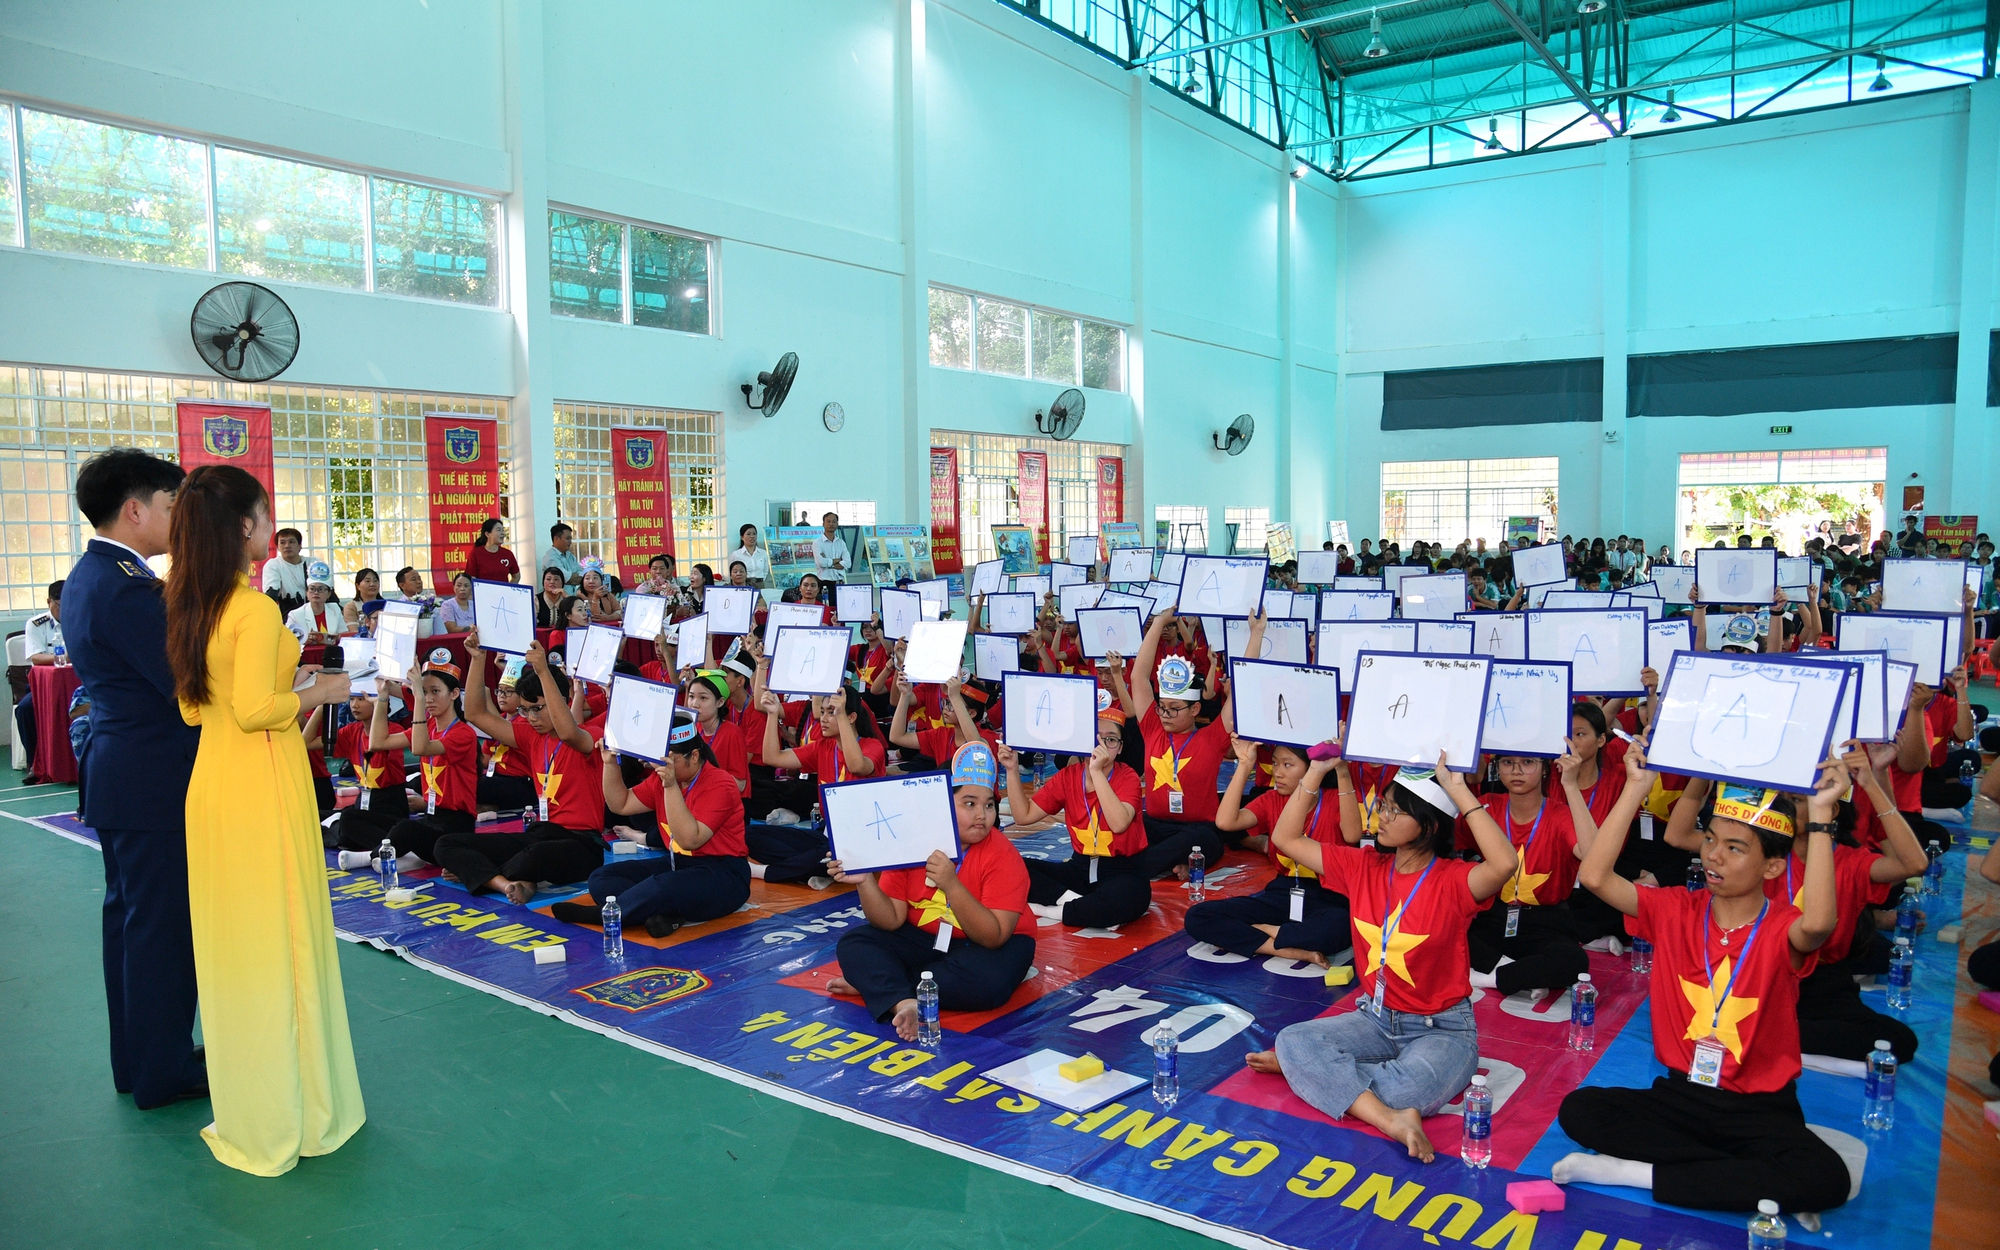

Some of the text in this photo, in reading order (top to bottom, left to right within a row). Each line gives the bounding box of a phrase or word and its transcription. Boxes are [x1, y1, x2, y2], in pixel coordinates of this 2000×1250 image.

[440, 471, 487, 488] THẾ HỆ TRẺ
[618, 478, 664, 492] HÃY TRÁNH XA
[432, 490, 495, 508] LÀ NGUỒN LỰC
[630, 500, 640, 510] MA
[440, 508, 490, 524] PHÁT TRIỂN
[622, 517, 664, 529] VÌ TƯƠNG LAI
[449, 532, 470, 543] KINH
[625, 534, 638, 547] THẾ
[639, 534, 648, 549] HỆ
[622, 554, 630, 566] VÌ
[1124, 561, 1133, 573] A
[1728, 565, 1740, 584] A
[1913, 576, 1921, 587] A
[1196, 570, 1221, 605] A
[1673, 578, 1682, 590] A
[851, 599, 856, 608] A
[1078, 596, 1089, 608] A
[491, 596, 518, 633] A
[896, 609, 903, 629] A
[1007, 606, 1017, 618] A
[1348, 603, 1358, 620] A
[1106, 626, 1117, 636] A
[1489, 627, 1502, 652] A
[990, 650, 997, 662] A
[1572, 634, 1598, 665] A
[1880, 638, 1907, 659] A
[800, 646, 816, 675] A
[1361, 658, 1373, 668] 03
[1436, 661, 1451, 669] Ngọc
[1678, 657, 1691, 666] 02
[1500, 668, 1523, 679] Nguyễn
[1526, 669, 1544, 678] Nhật
[1037, 690, 1053, 726] A
[1277, 693, 1293, 729] A
[1388, 693, 1409, 719] A
[1486, 693, 1513, 728] A
[632, 710, 642, 726] A
[1711, 693, 1748, 740] A
[679, 730, 691, 740] TIM
[1714, 802, 1738, 816] THCS
[866, 801, 903, 840] A
[407, 904, 500, 933] YÊU
[475, 922, 570, 953] EM
[1069, 985, 1255, 1053] 04
[1699, 1074, 1712, 1082] 02
[740, 1010, 1539, 1250] VÙNG CẢNH SÁT BIỂN 4
